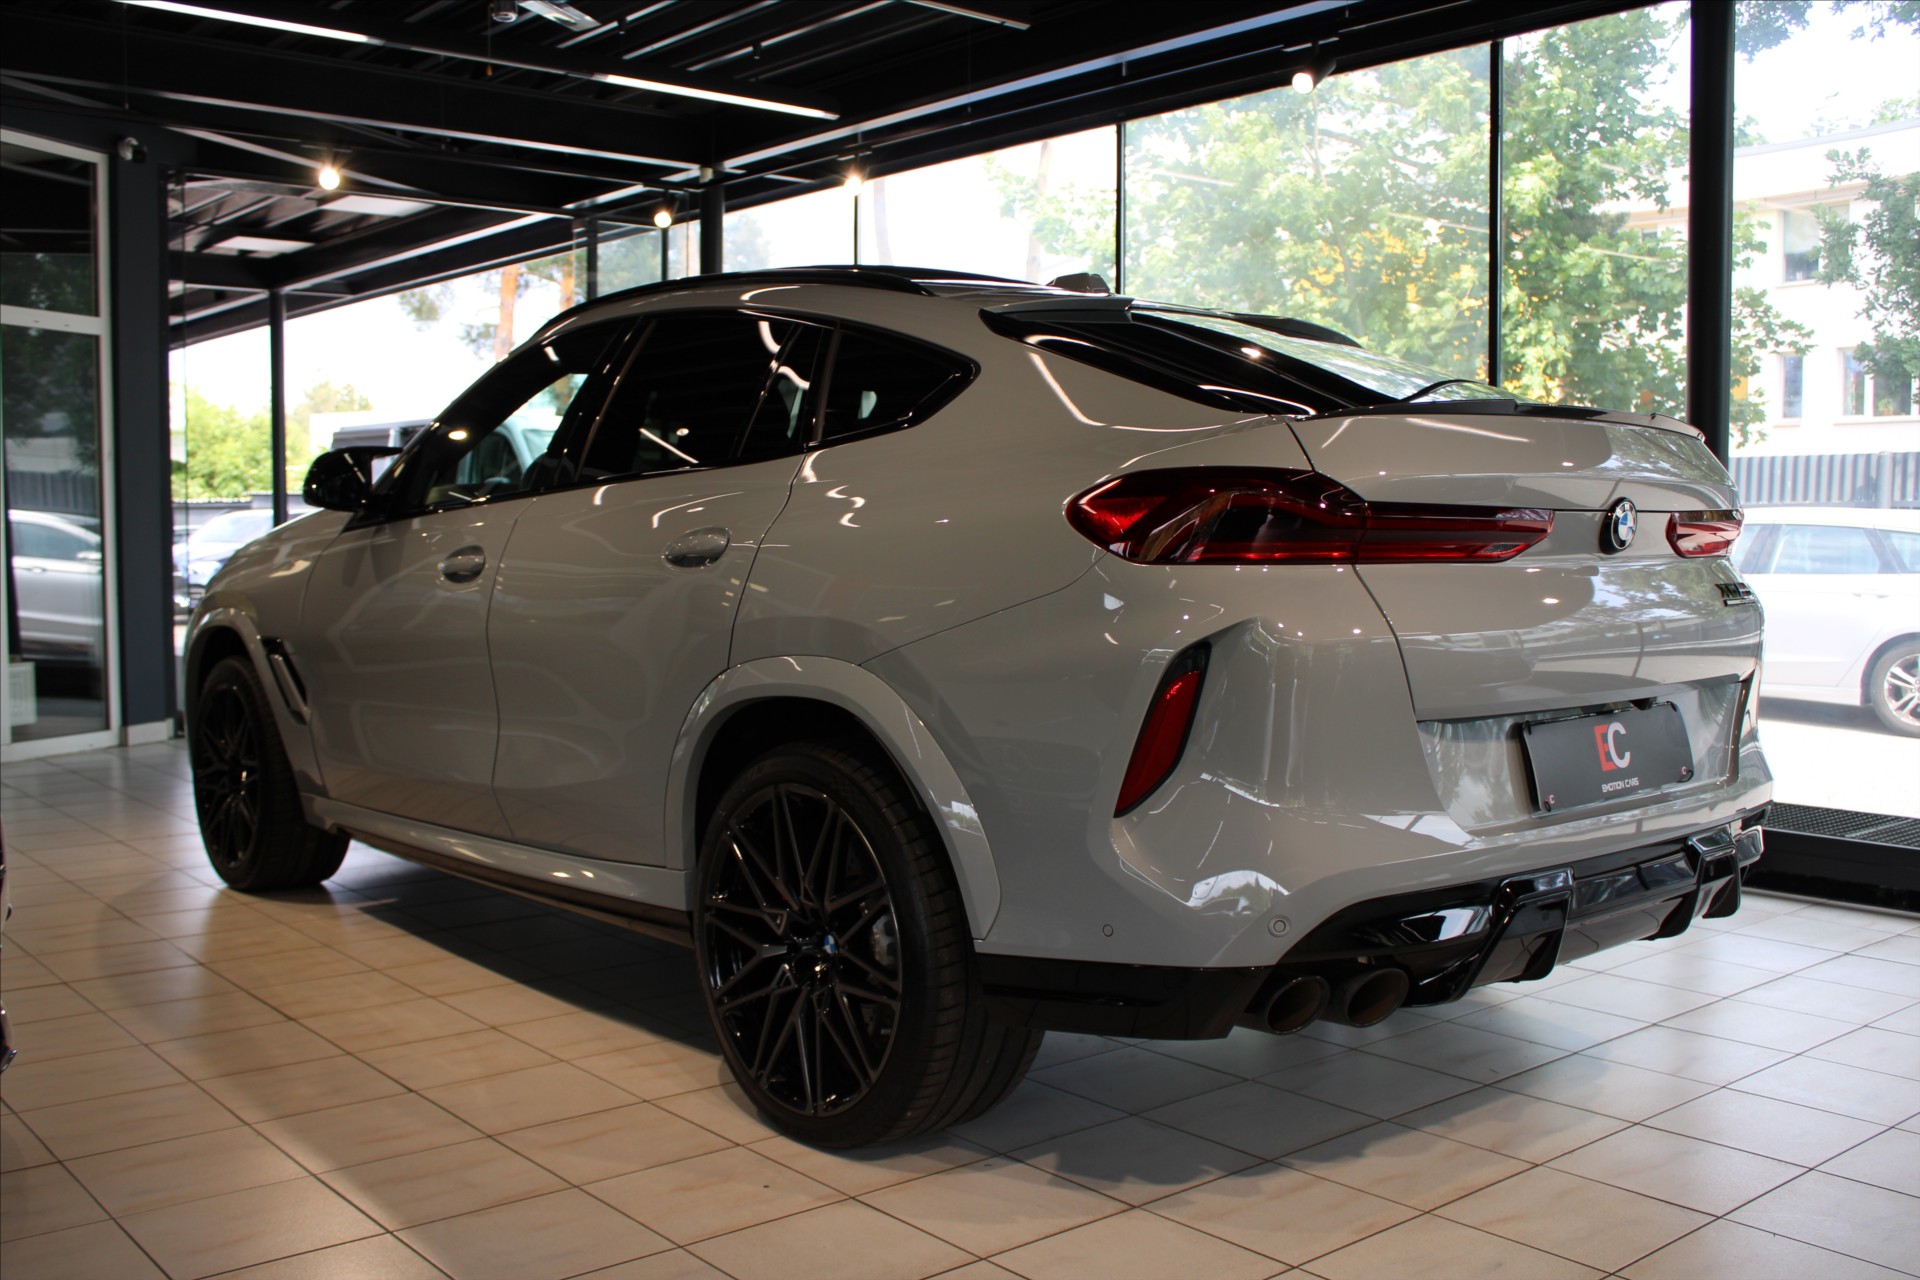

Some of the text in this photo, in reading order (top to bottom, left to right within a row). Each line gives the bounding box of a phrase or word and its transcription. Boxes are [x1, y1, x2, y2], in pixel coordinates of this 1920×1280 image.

[1593, 722, 1631, 772] EC
[1601, 777, 1640, 793] EMOTION CARS
